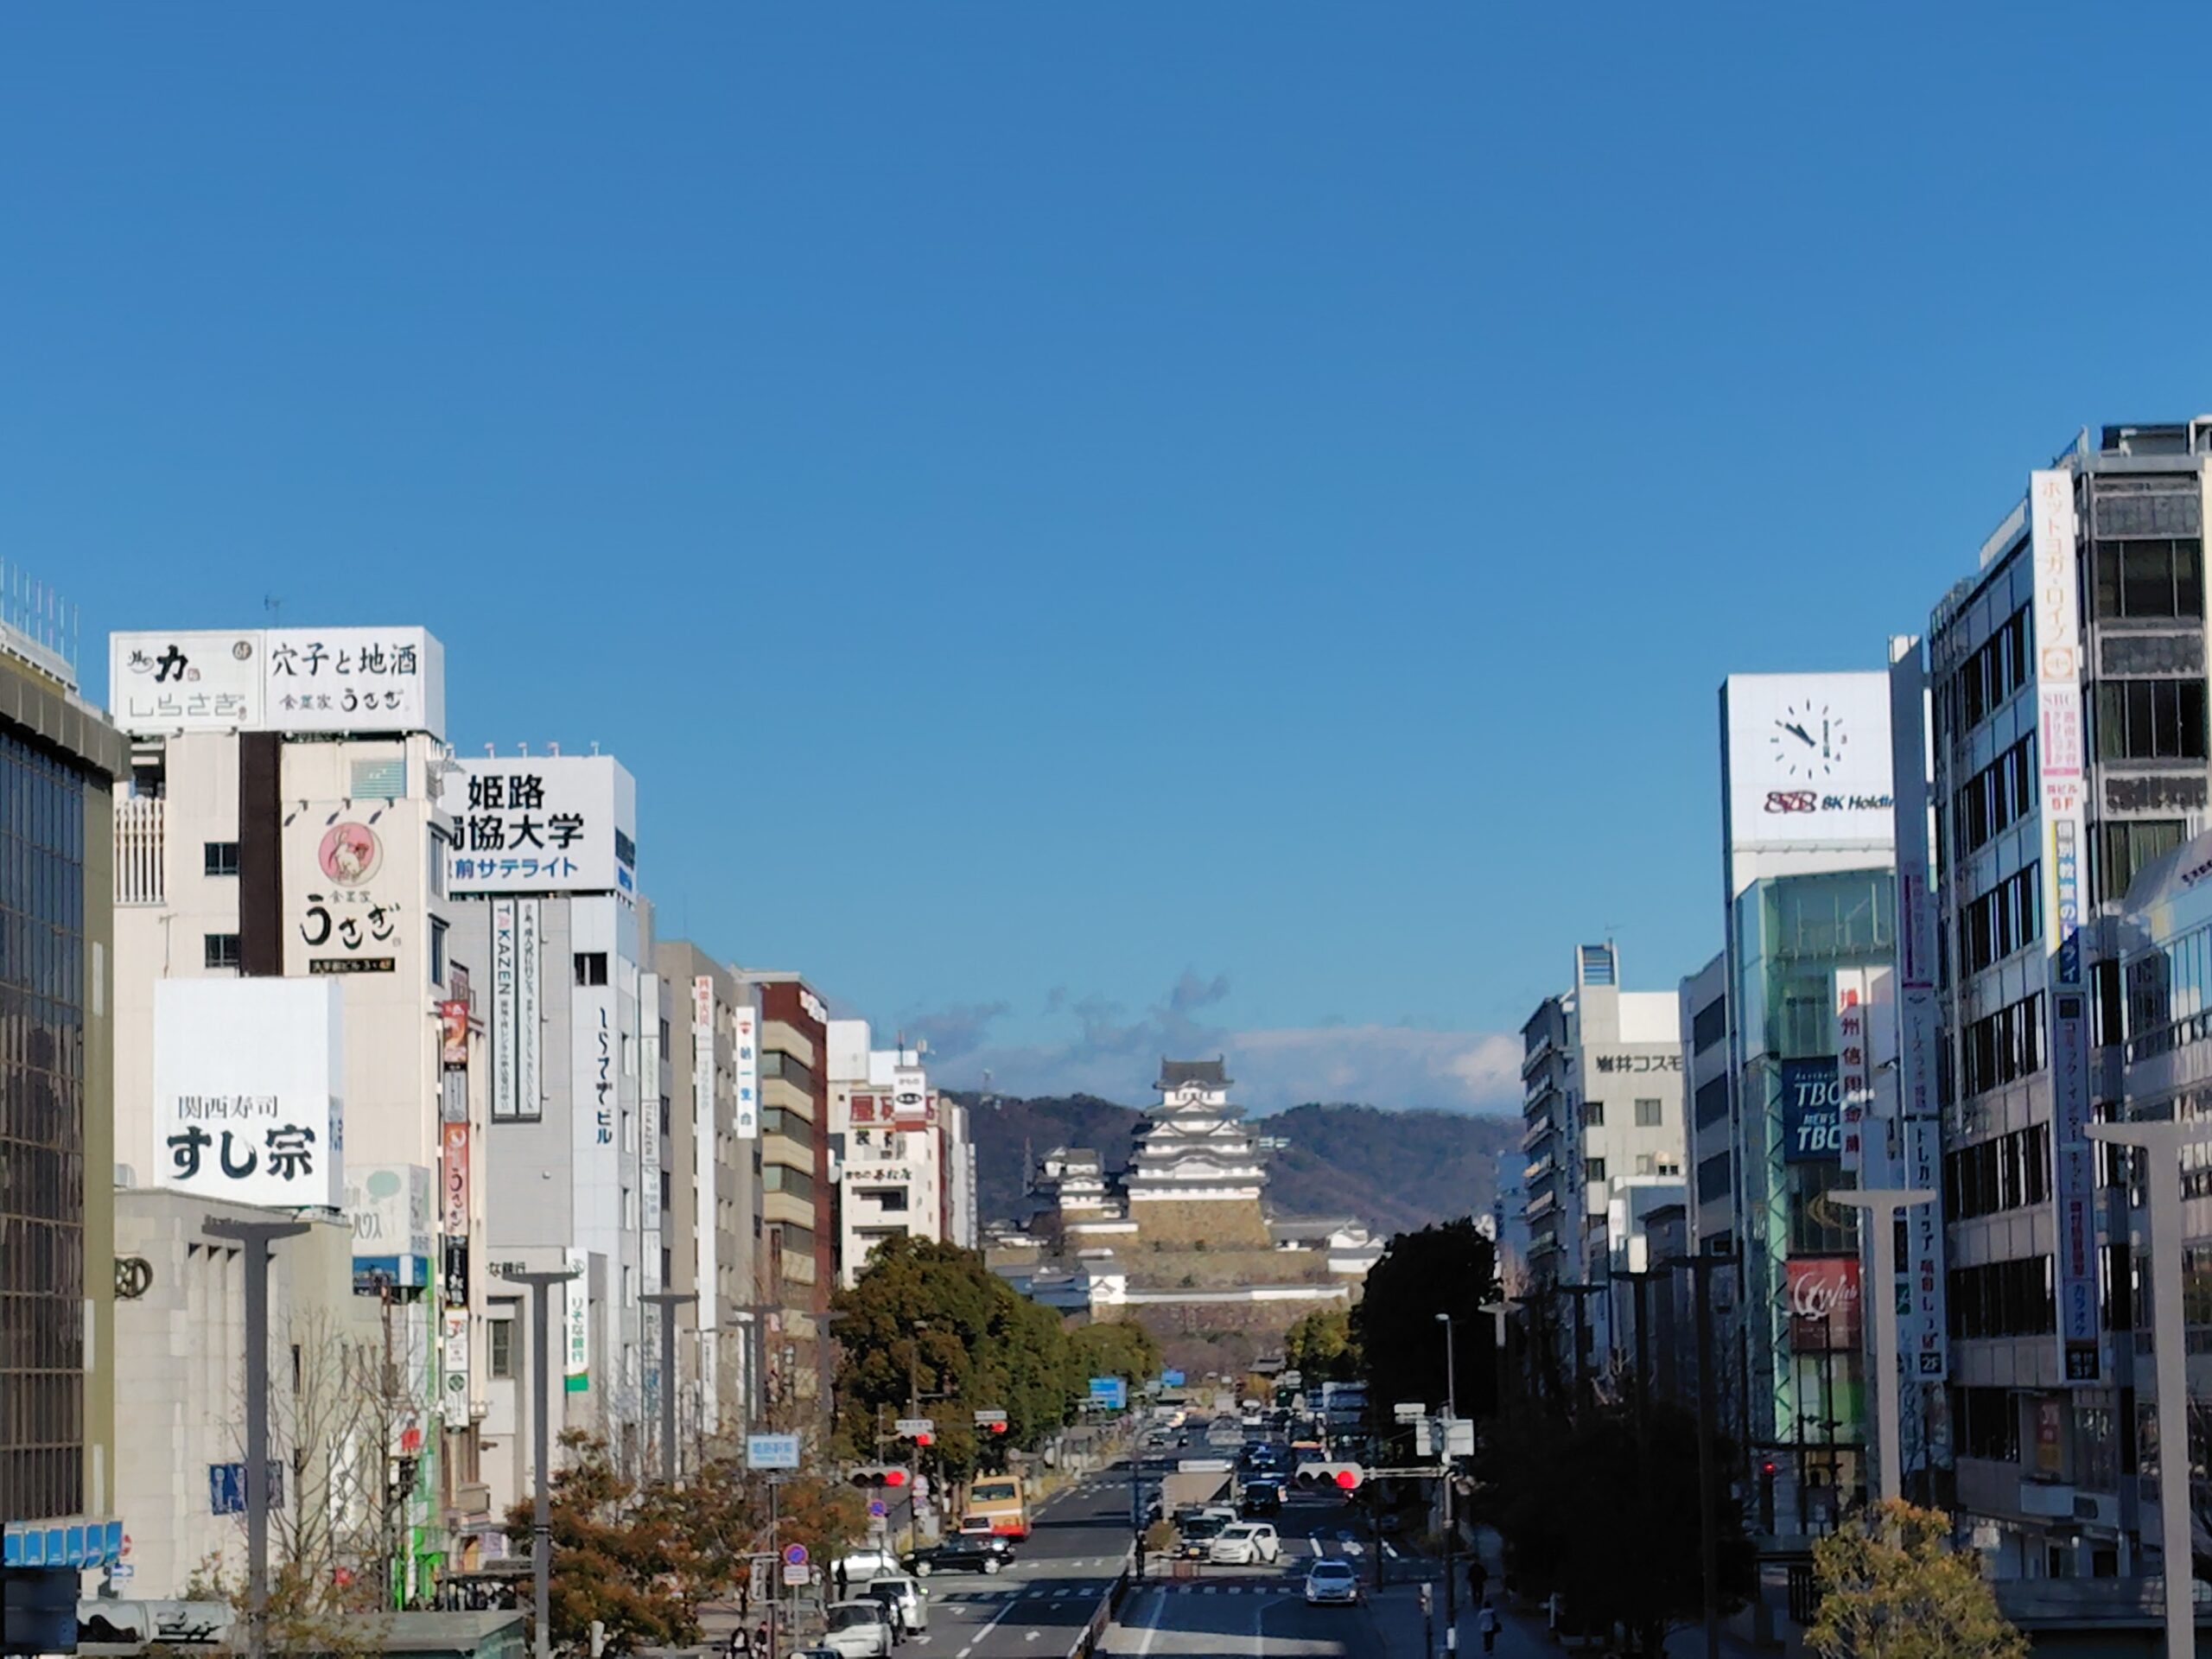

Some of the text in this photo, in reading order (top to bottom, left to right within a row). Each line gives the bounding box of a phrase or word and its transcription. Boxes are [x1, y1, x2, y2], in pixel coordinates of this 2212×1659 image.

[271, 642, 416, 677] 穴子と地酒
[340, 689, 404, 712] うさぎ
[467, 774, 544, 810] 姫路
[1821, 795, 1844, 810] BK
[448, 856, 577, 879] 前サテライト
[299, 893, 401, 950] うさぎ
[497, 904, 512, 995] TAKAZEN
[178, 1095, 278, 1120] 関西寿司
[167, 1123, 316, 1181] すし宗
[571, 1298, 584, 1363] りそな銀行
